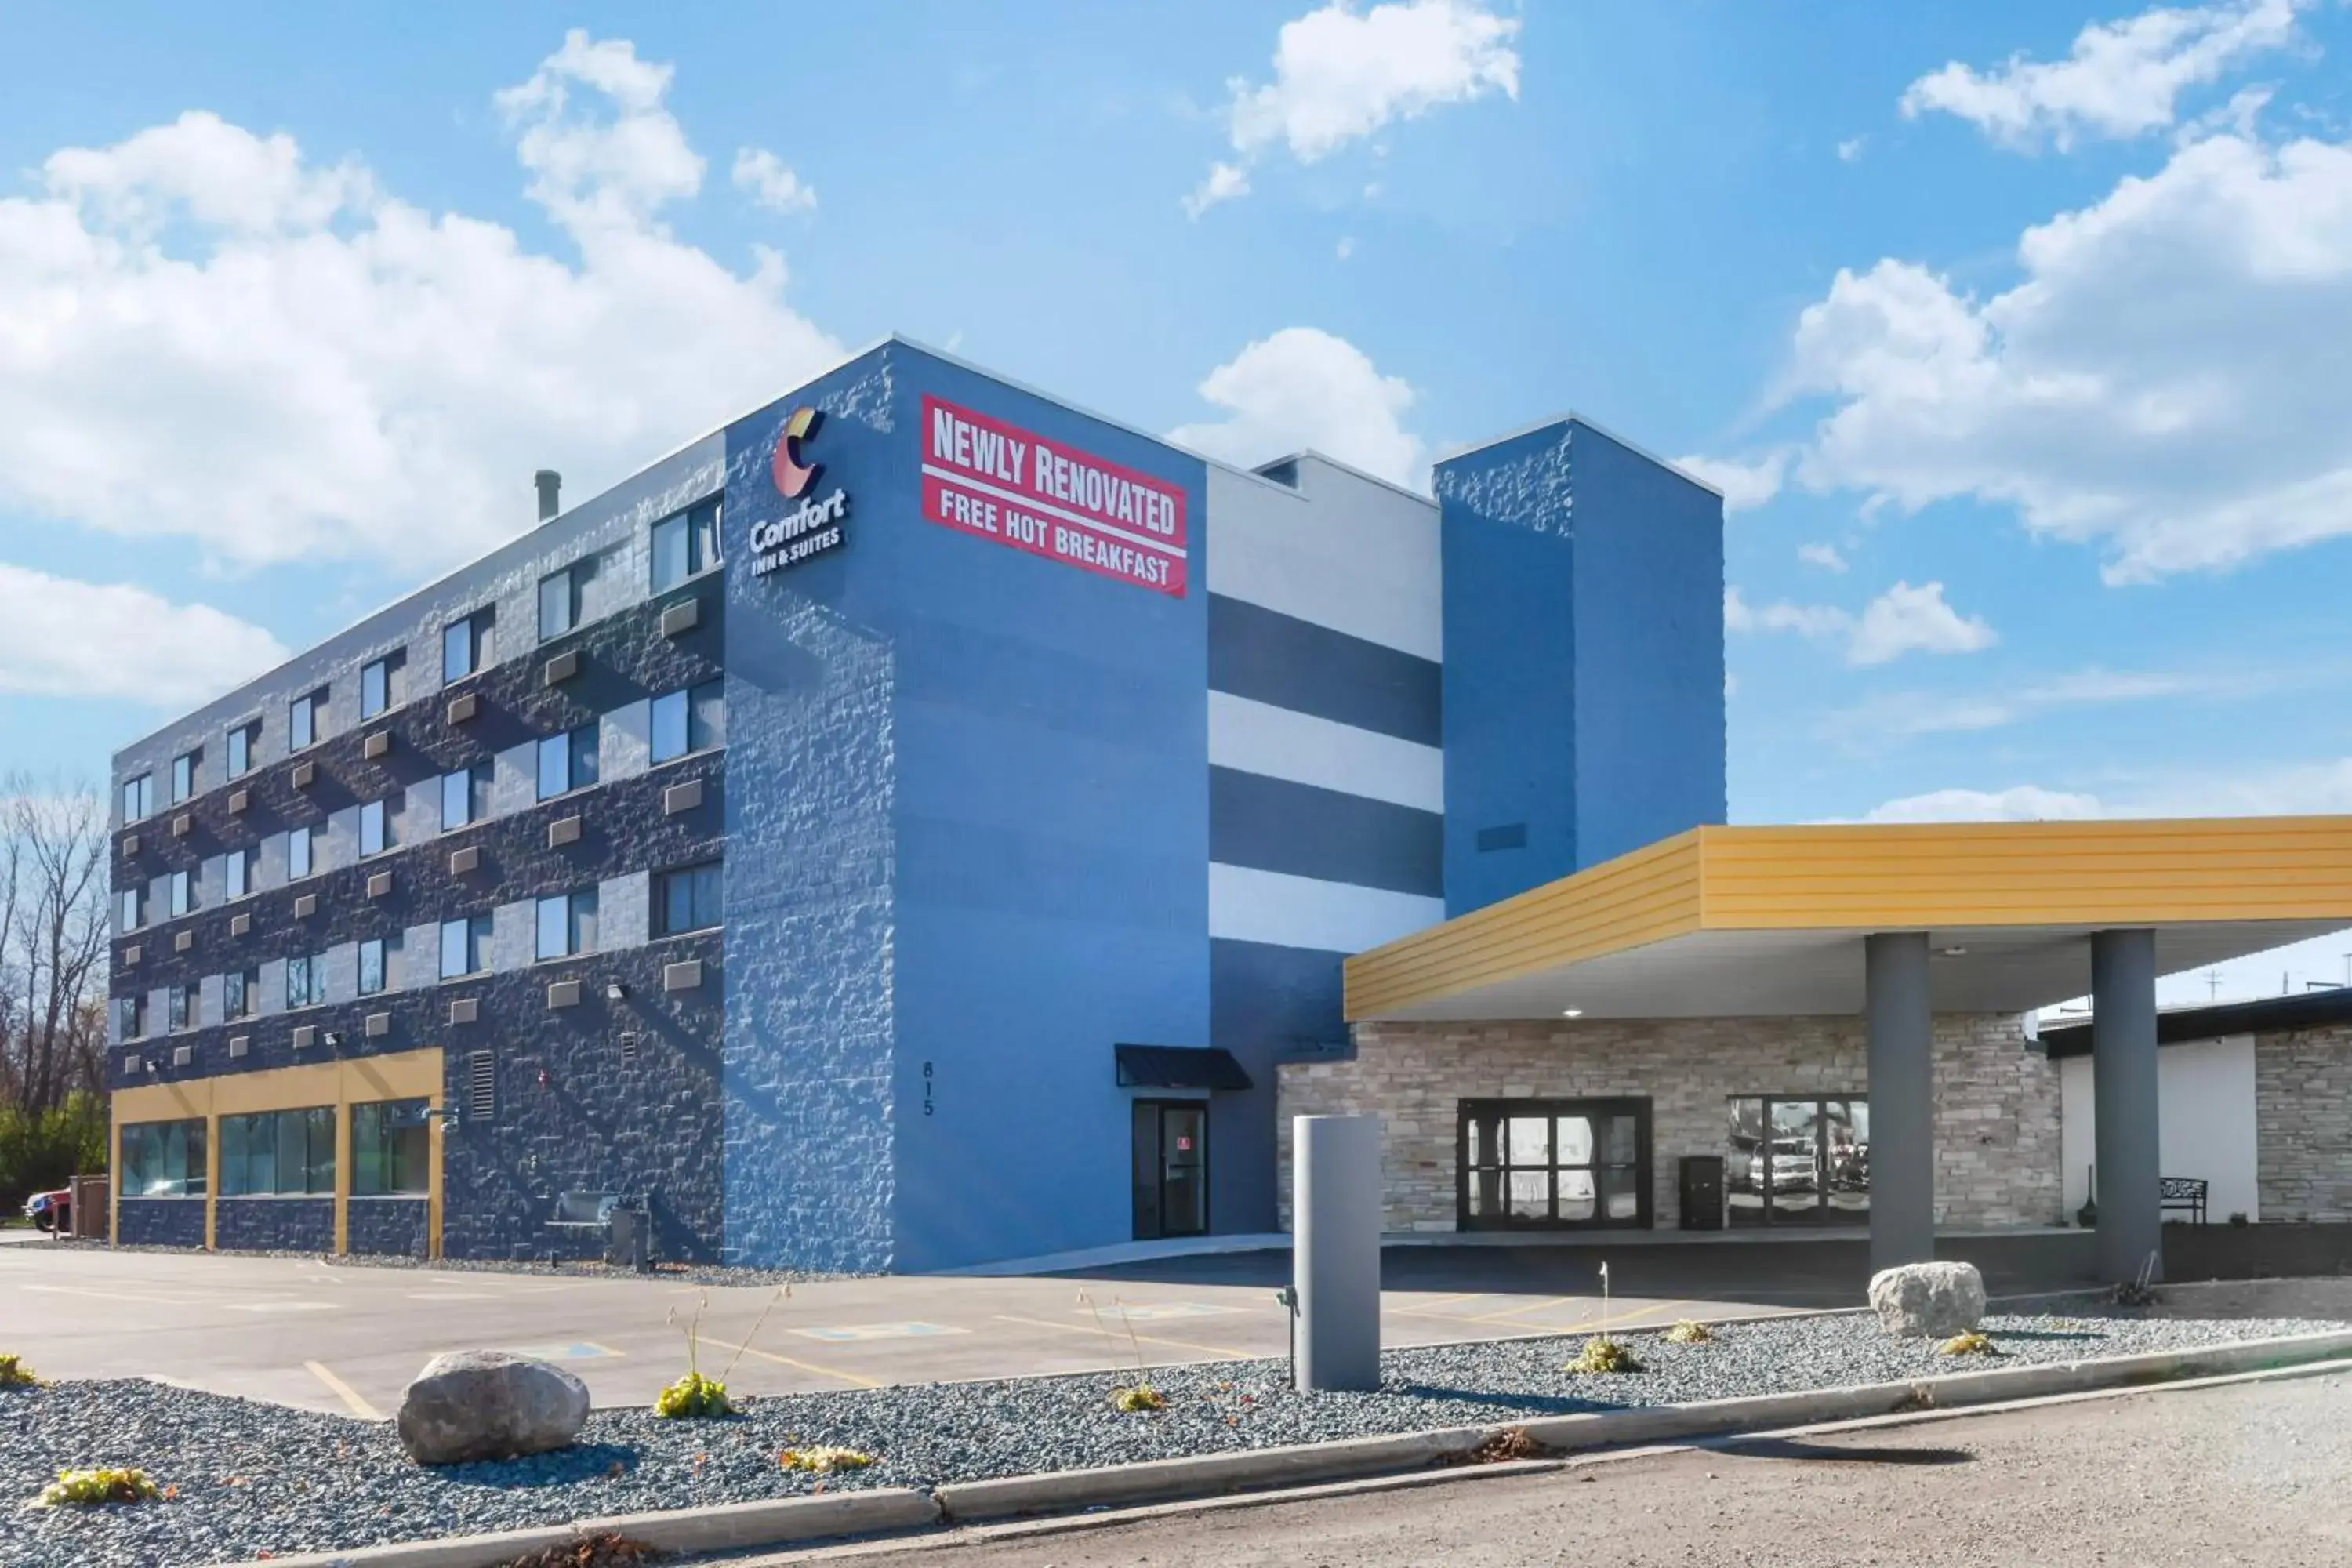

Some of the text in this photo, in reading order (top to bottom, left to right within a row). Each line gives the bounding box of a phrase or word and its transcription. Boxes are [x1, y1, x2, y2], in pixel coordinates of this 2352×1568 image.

[934, 407, 1175, 535] NEWLY RENOVATED
[750, 488, 845, 553] Comfort
[752, 527, 840, 576] INN & SUITES
[941, 489, 1168, 586] FREE HOT BREAKFAST
